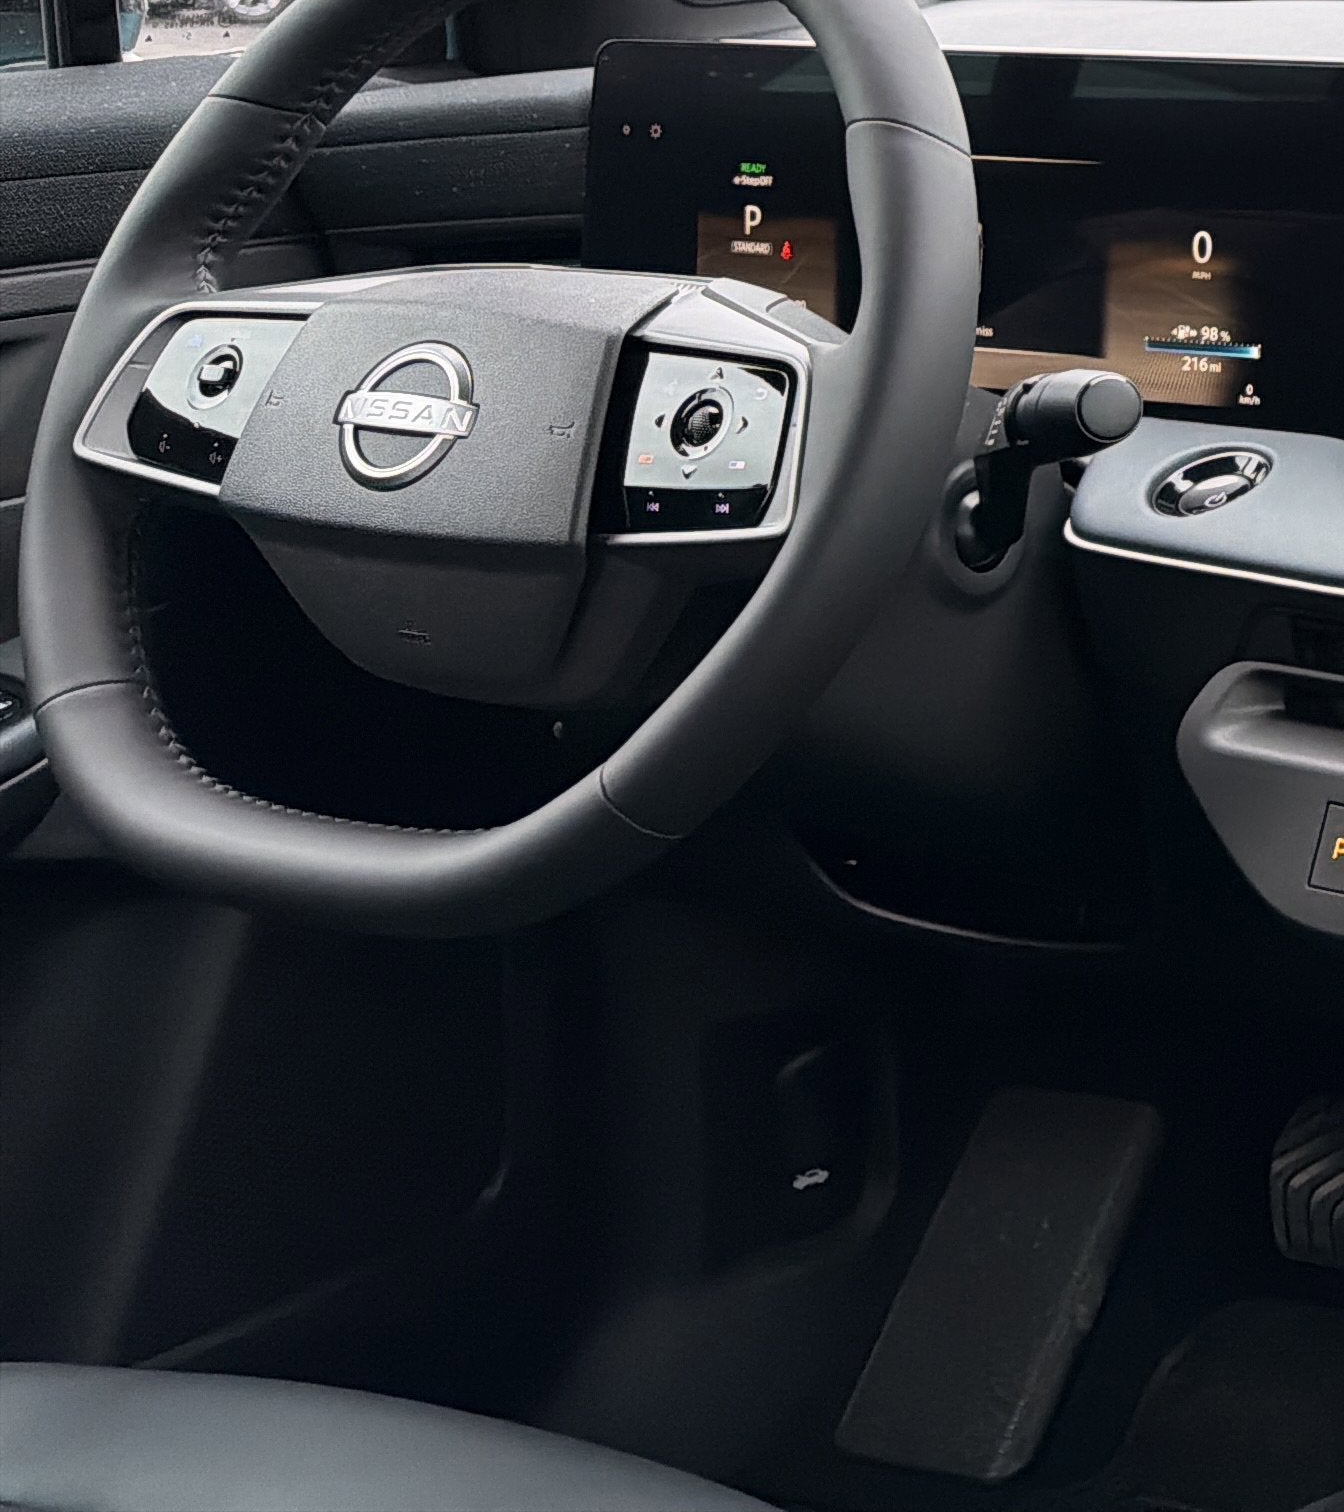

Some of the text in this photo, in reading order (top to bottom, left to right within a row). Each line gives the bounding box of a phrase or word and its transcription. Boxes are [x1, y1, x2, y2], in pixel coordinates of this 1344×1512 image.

[740, 162, 767, 173] READY
[743, 204, 763, 235] P
[733, 242, 770, 255] STANDARD
[1192, 230, 1213, 264] 0
[1191, 271, 1211, 280] MPH
[1181, 356, 1208, 372] 216
[1238, 394, 1261, 406] km/h
[339, 397, 474, 432] NISSAN
